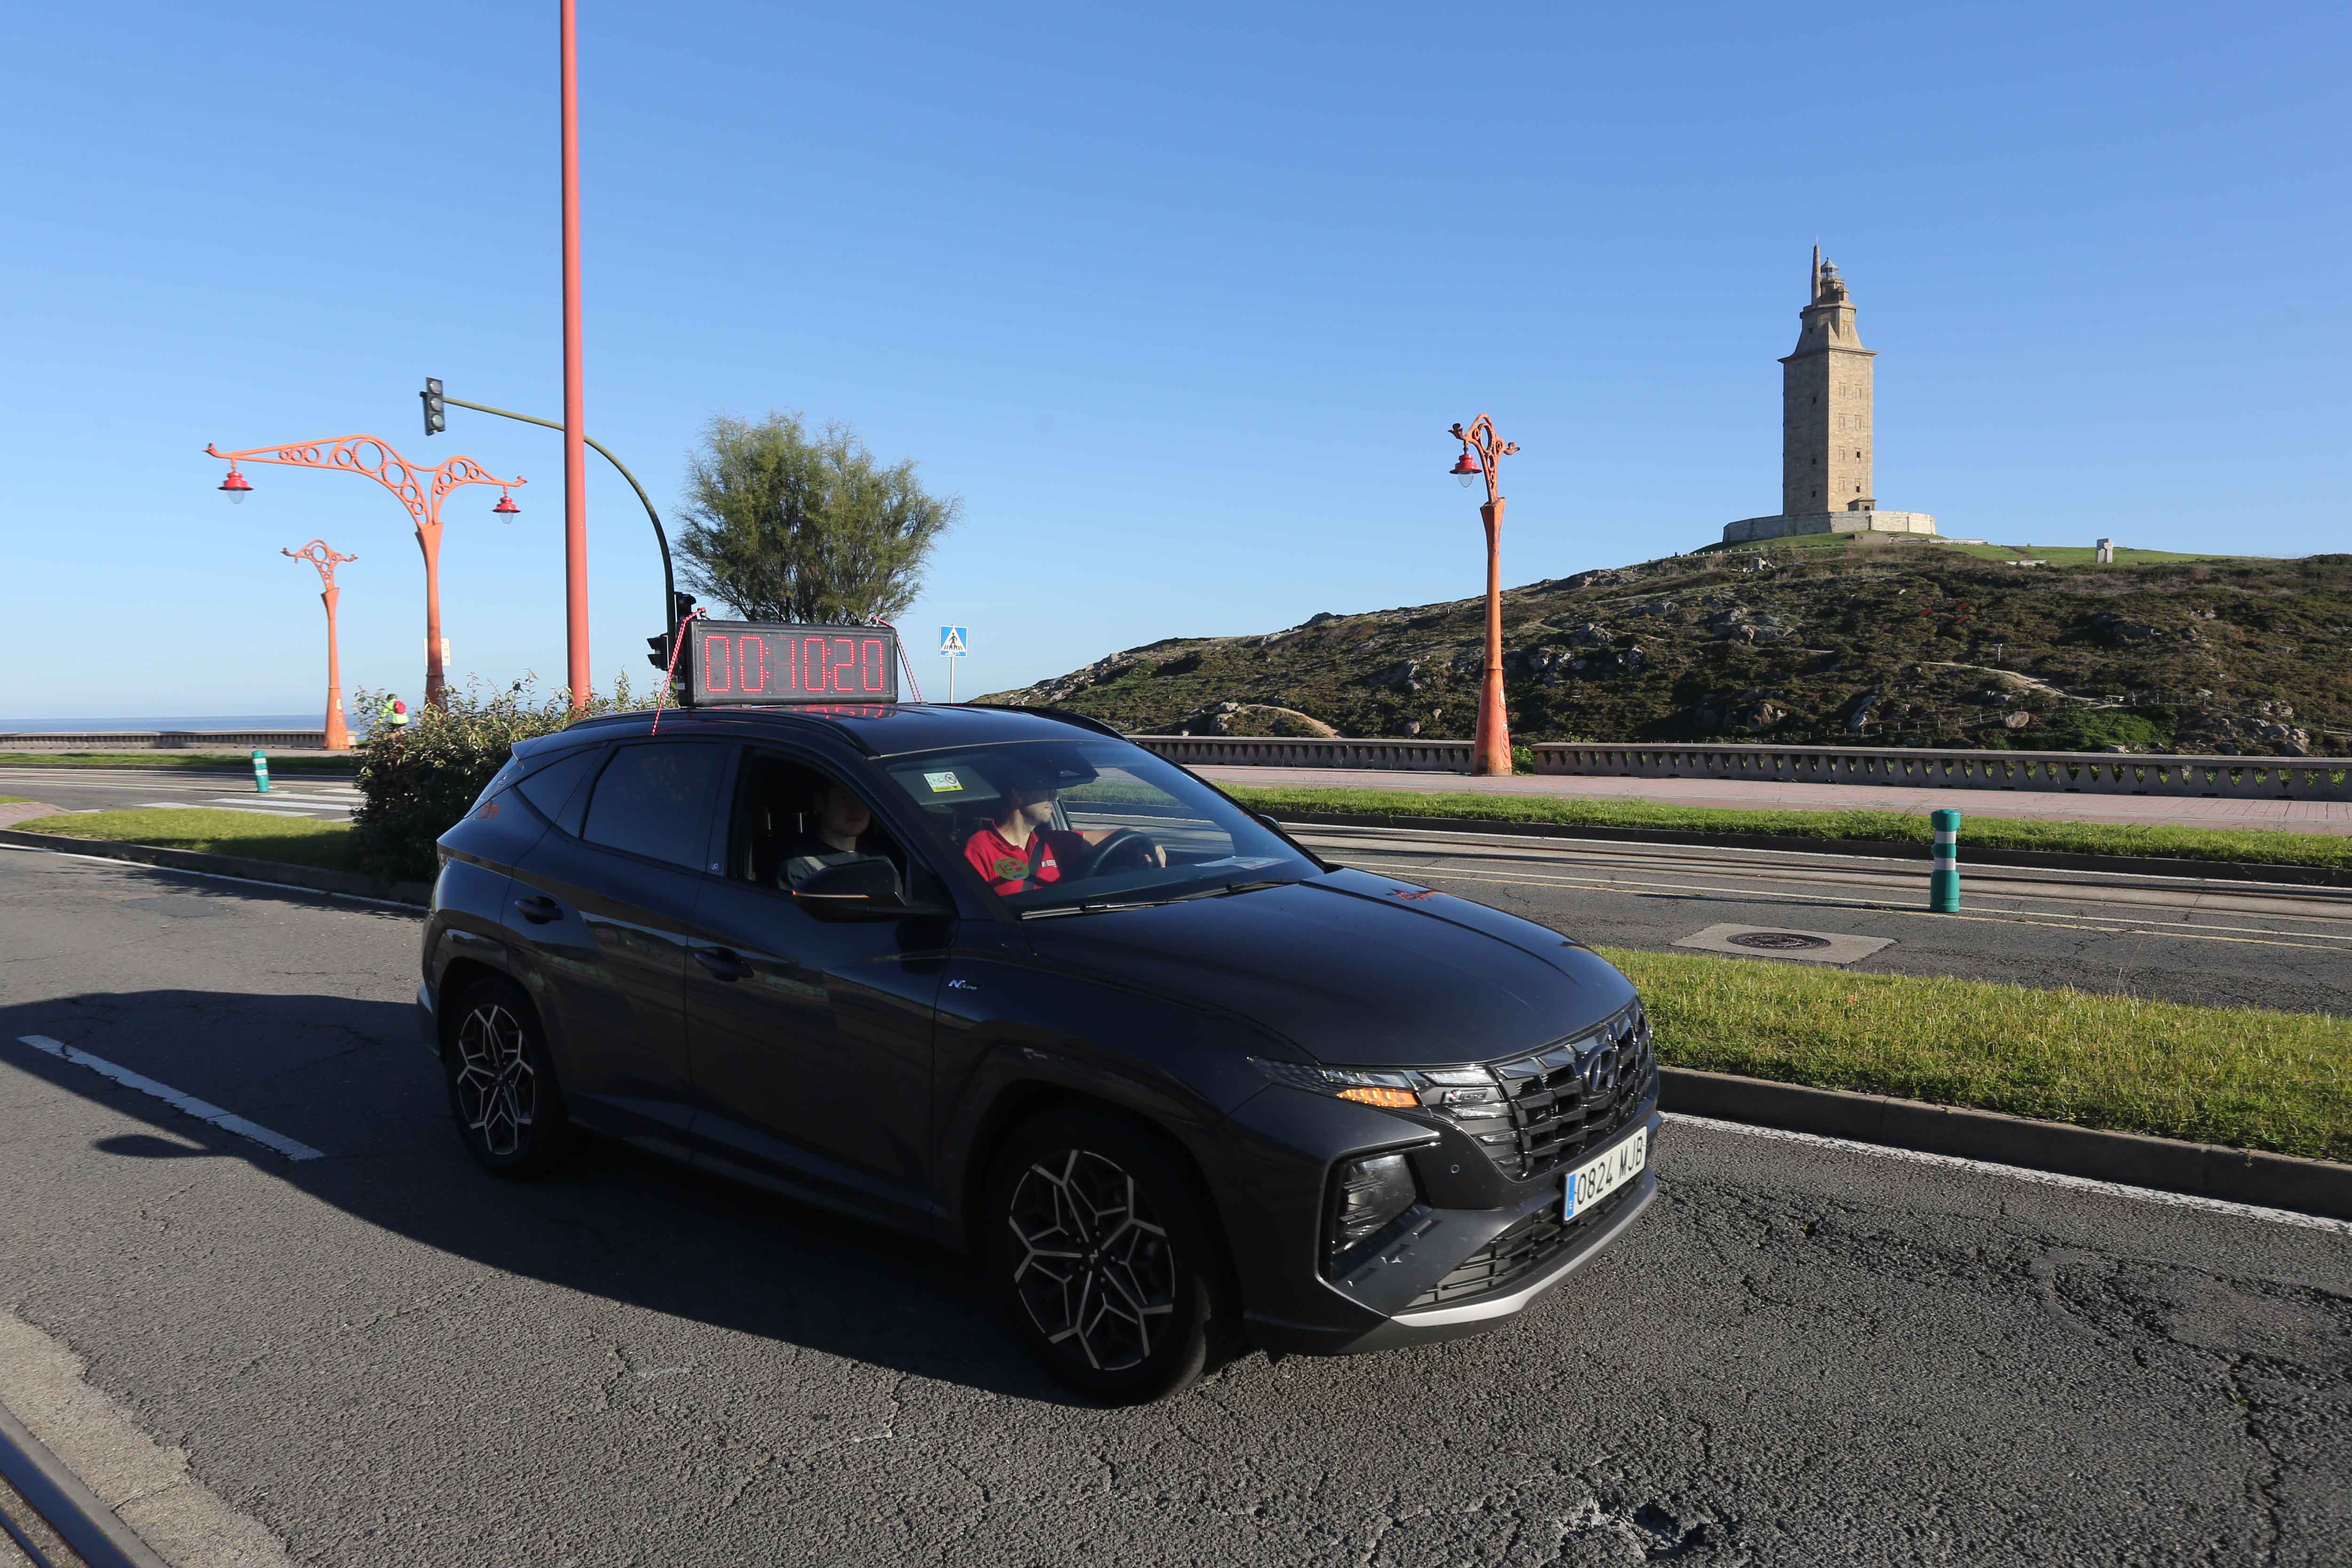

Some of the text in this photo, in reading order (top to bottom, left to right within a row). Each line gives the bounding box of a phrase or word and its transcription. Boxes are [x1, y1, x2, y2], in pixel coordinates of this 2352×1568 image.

[705, 635, 884, 692] 00:10:20
[1577, 1136, 1643, 1205] 0824 MJB
